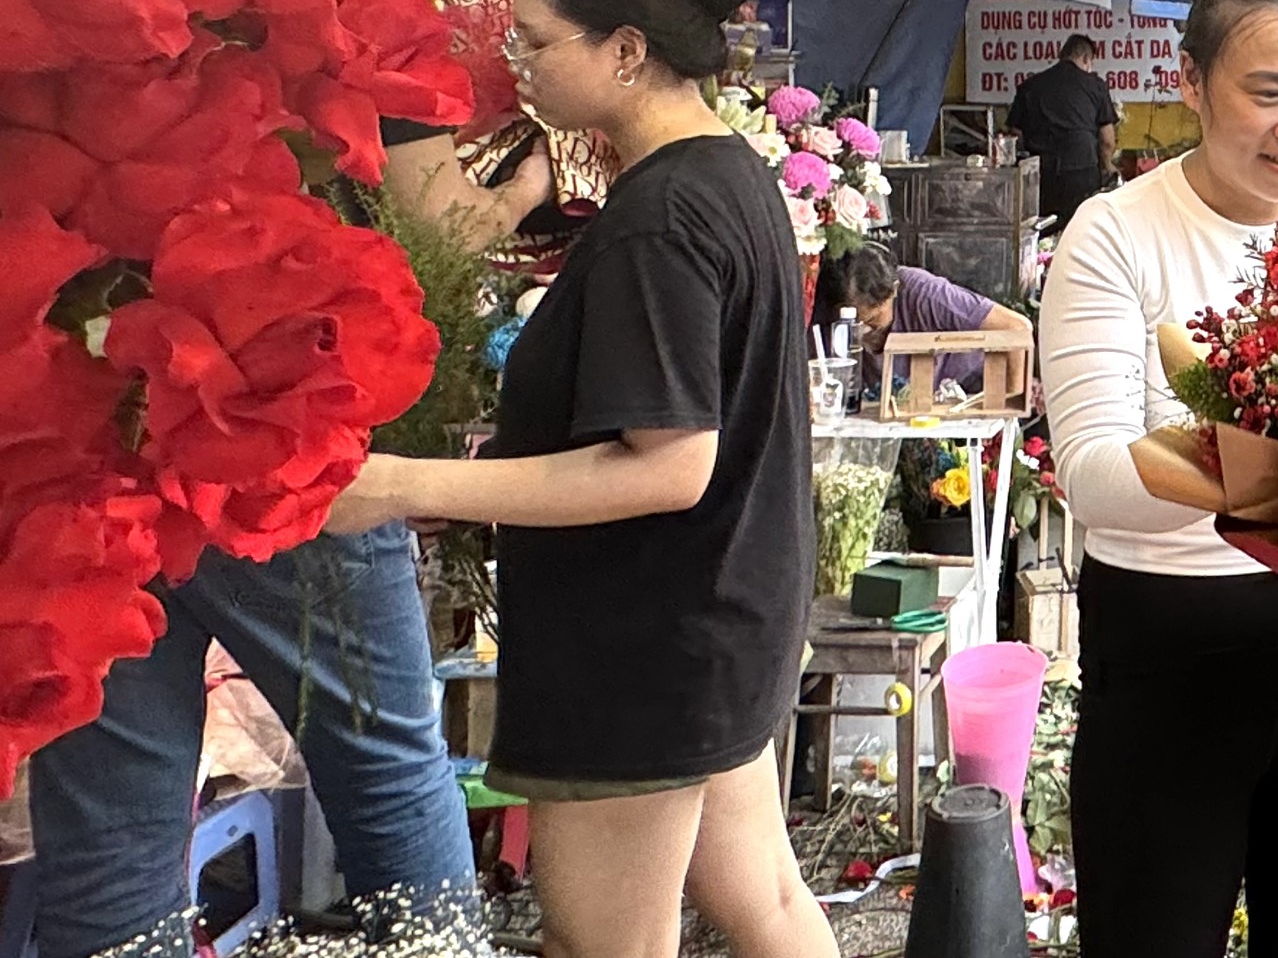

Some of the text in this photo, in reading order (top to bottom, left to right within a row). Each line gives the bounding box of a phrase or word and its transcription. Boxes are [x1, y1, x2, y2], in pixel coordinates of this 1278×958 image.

[981, 11, 1022, 34] DỤNG
[1027, 11, 1048, 34] CỤ
[1052, 4, 1080, 30] HỚT
[982, 36, 1017, 61] CÁC
[1112, 32, 1144, 59] CẮT
[1150, 39, 1172, 59] DA
[981, 72, 1008, 92] ĐT:
[1107, 70, 1139, 90] 608
